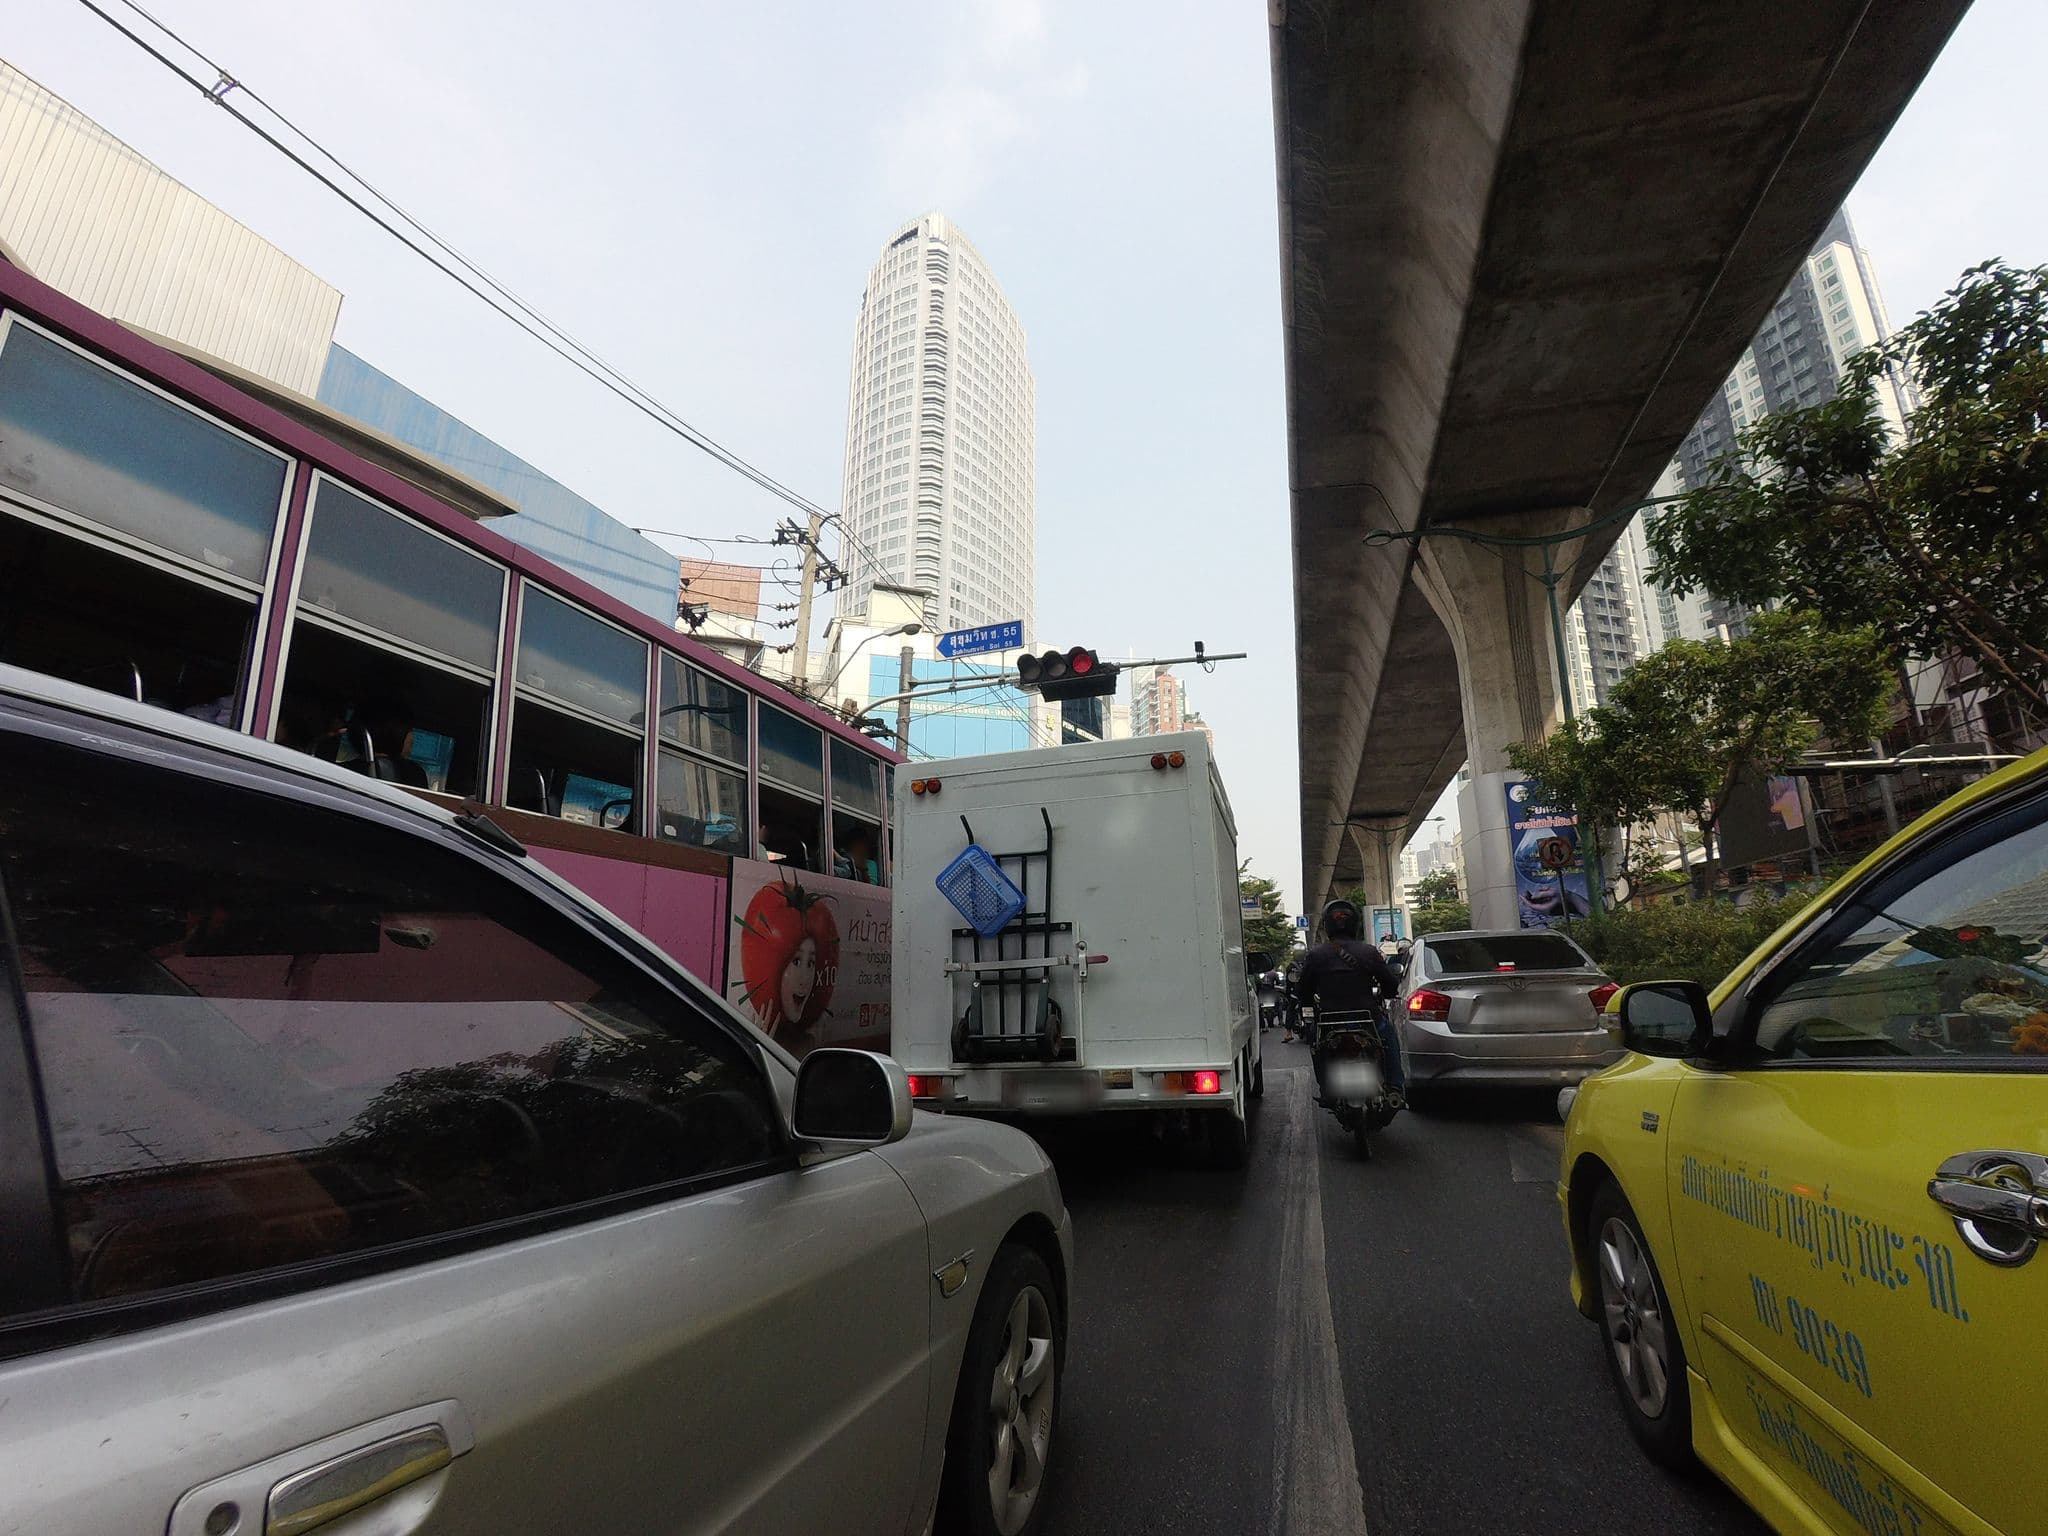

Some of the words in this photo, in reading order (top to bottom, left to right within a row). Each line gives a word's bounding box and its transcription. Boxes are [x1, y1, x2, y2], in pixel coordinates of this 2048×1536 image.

[950, 630, 988, 648] สุขุมวิท
[1003, 626, 1017, 637] 55
[952, 645, 985, 655] Sukhumvit
[1786, 1295, 1874, 1400] 9039
